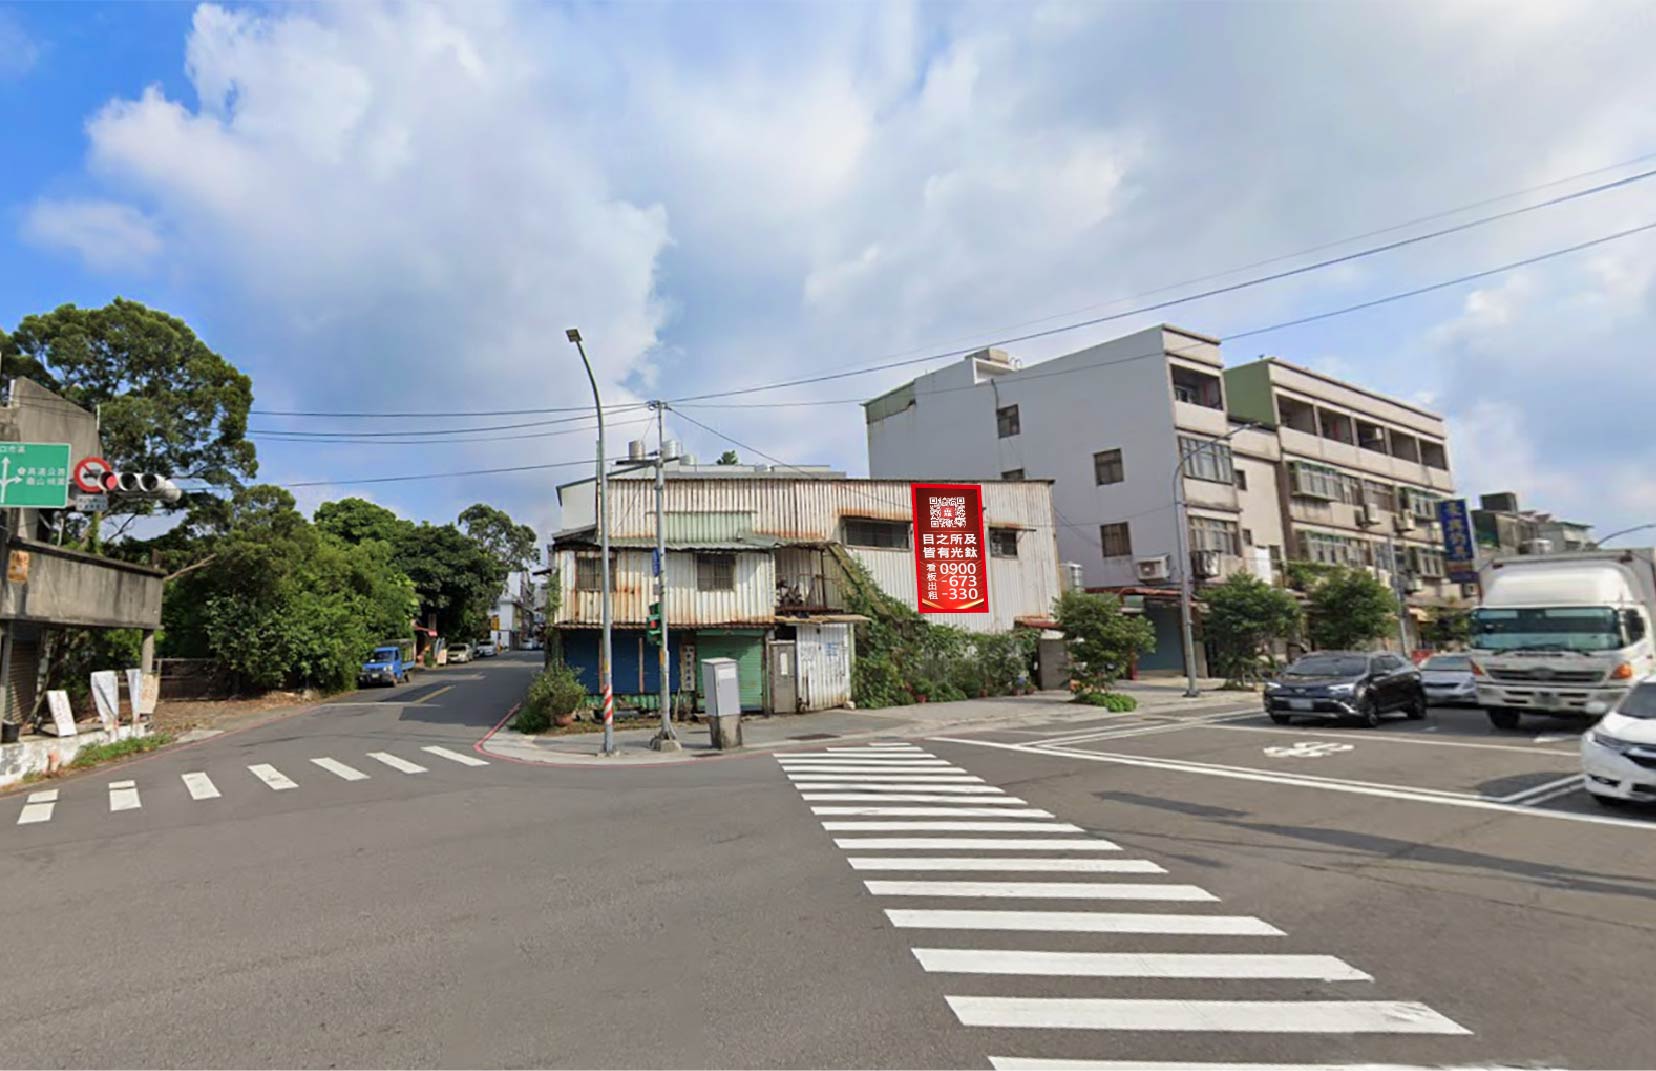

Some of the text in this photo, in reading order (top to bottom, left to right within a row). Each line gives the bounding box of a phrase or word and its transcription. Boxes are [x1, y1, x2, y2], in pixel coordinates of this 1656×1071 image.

[923, 533, 977, 545] 目之所及
[923, 547, 978, 558] 皆有光鈦
[940, 563, 976, 575] 0900
[926, 563, 938, 600] 看板出租
[941, 575, 977, 587] -673
[941, 588, 978, 600] -330
